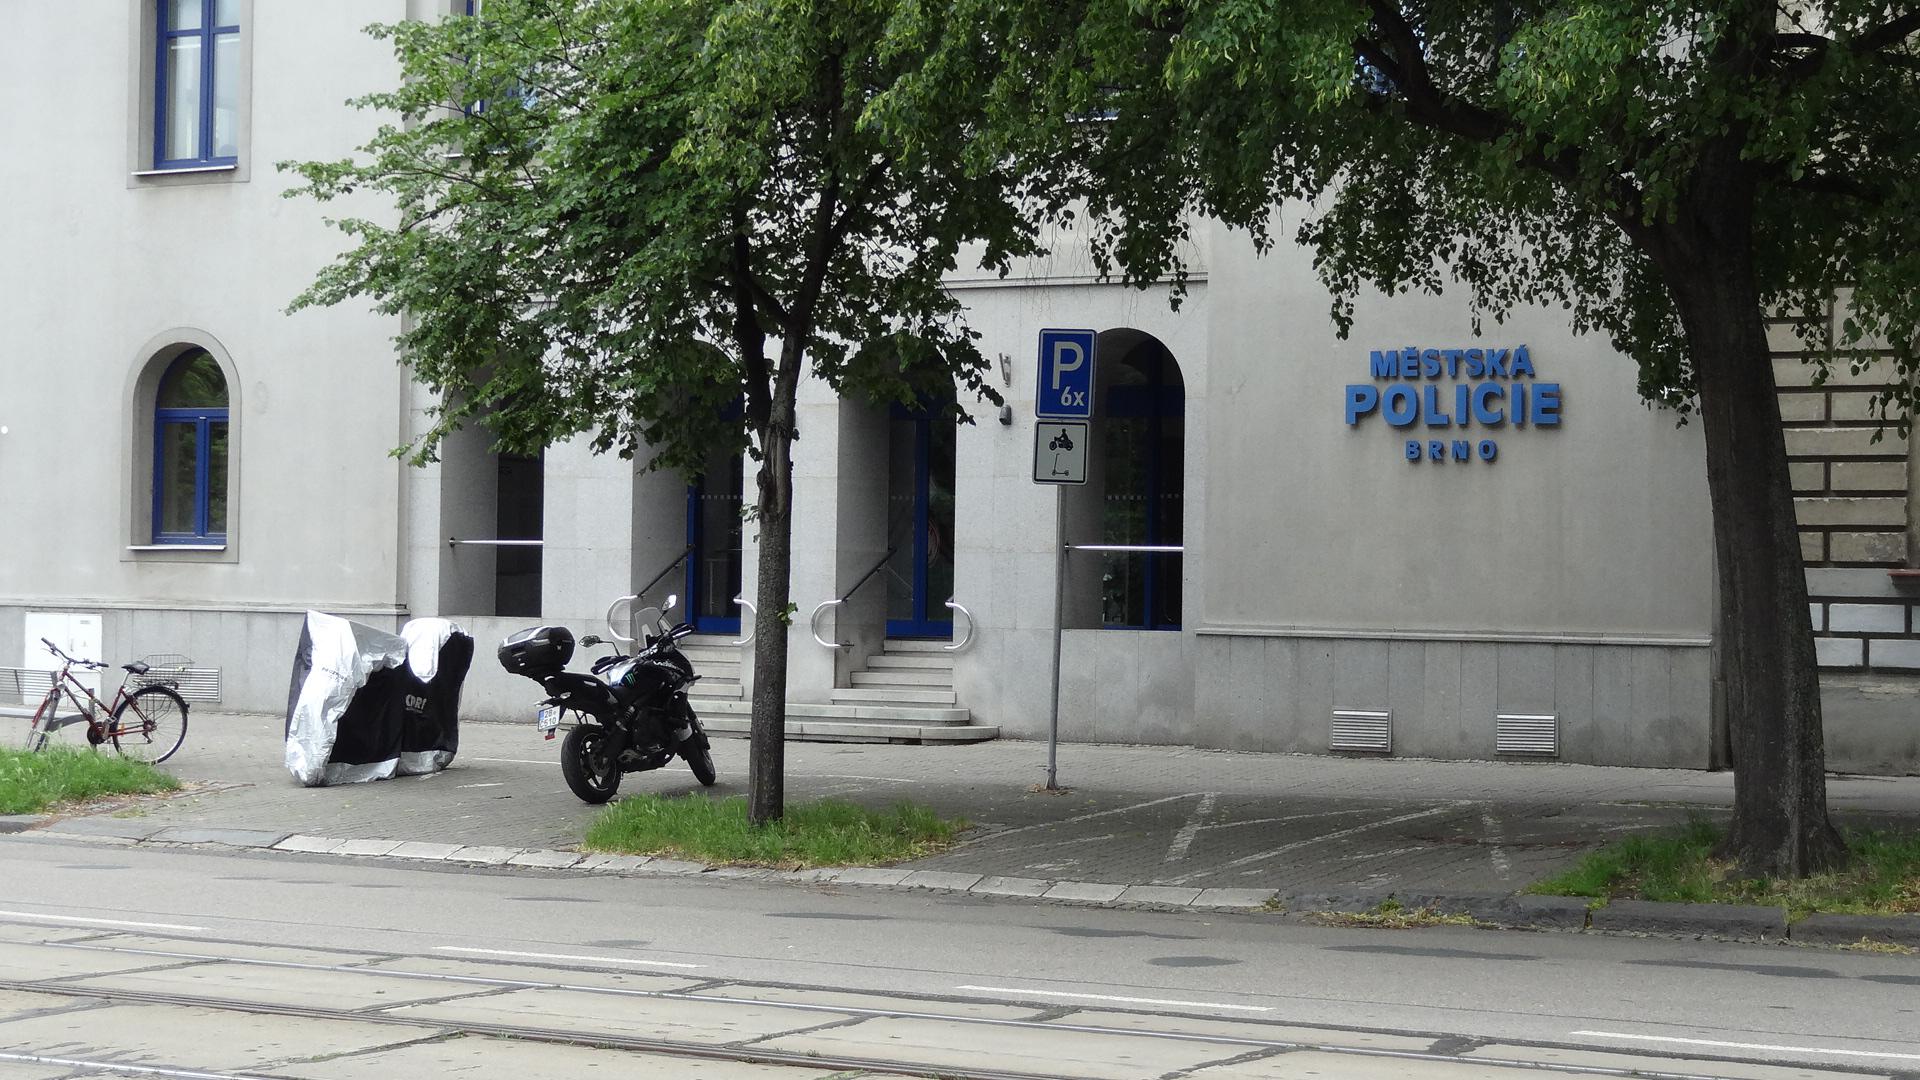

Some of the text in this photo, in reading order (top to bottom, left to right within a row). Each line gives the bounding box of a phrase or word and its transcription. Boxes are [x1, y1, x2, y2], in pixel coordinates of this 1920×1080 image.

[1052, 341, 1084, 390] P
[1370, 344, 1535, 378] MĚSTSKÁ
[1061, 386, 1085, 406] 6x
[1345, 382, 1562, 426] POLICIE
[1406, 440, 1497, 460] BRNO
